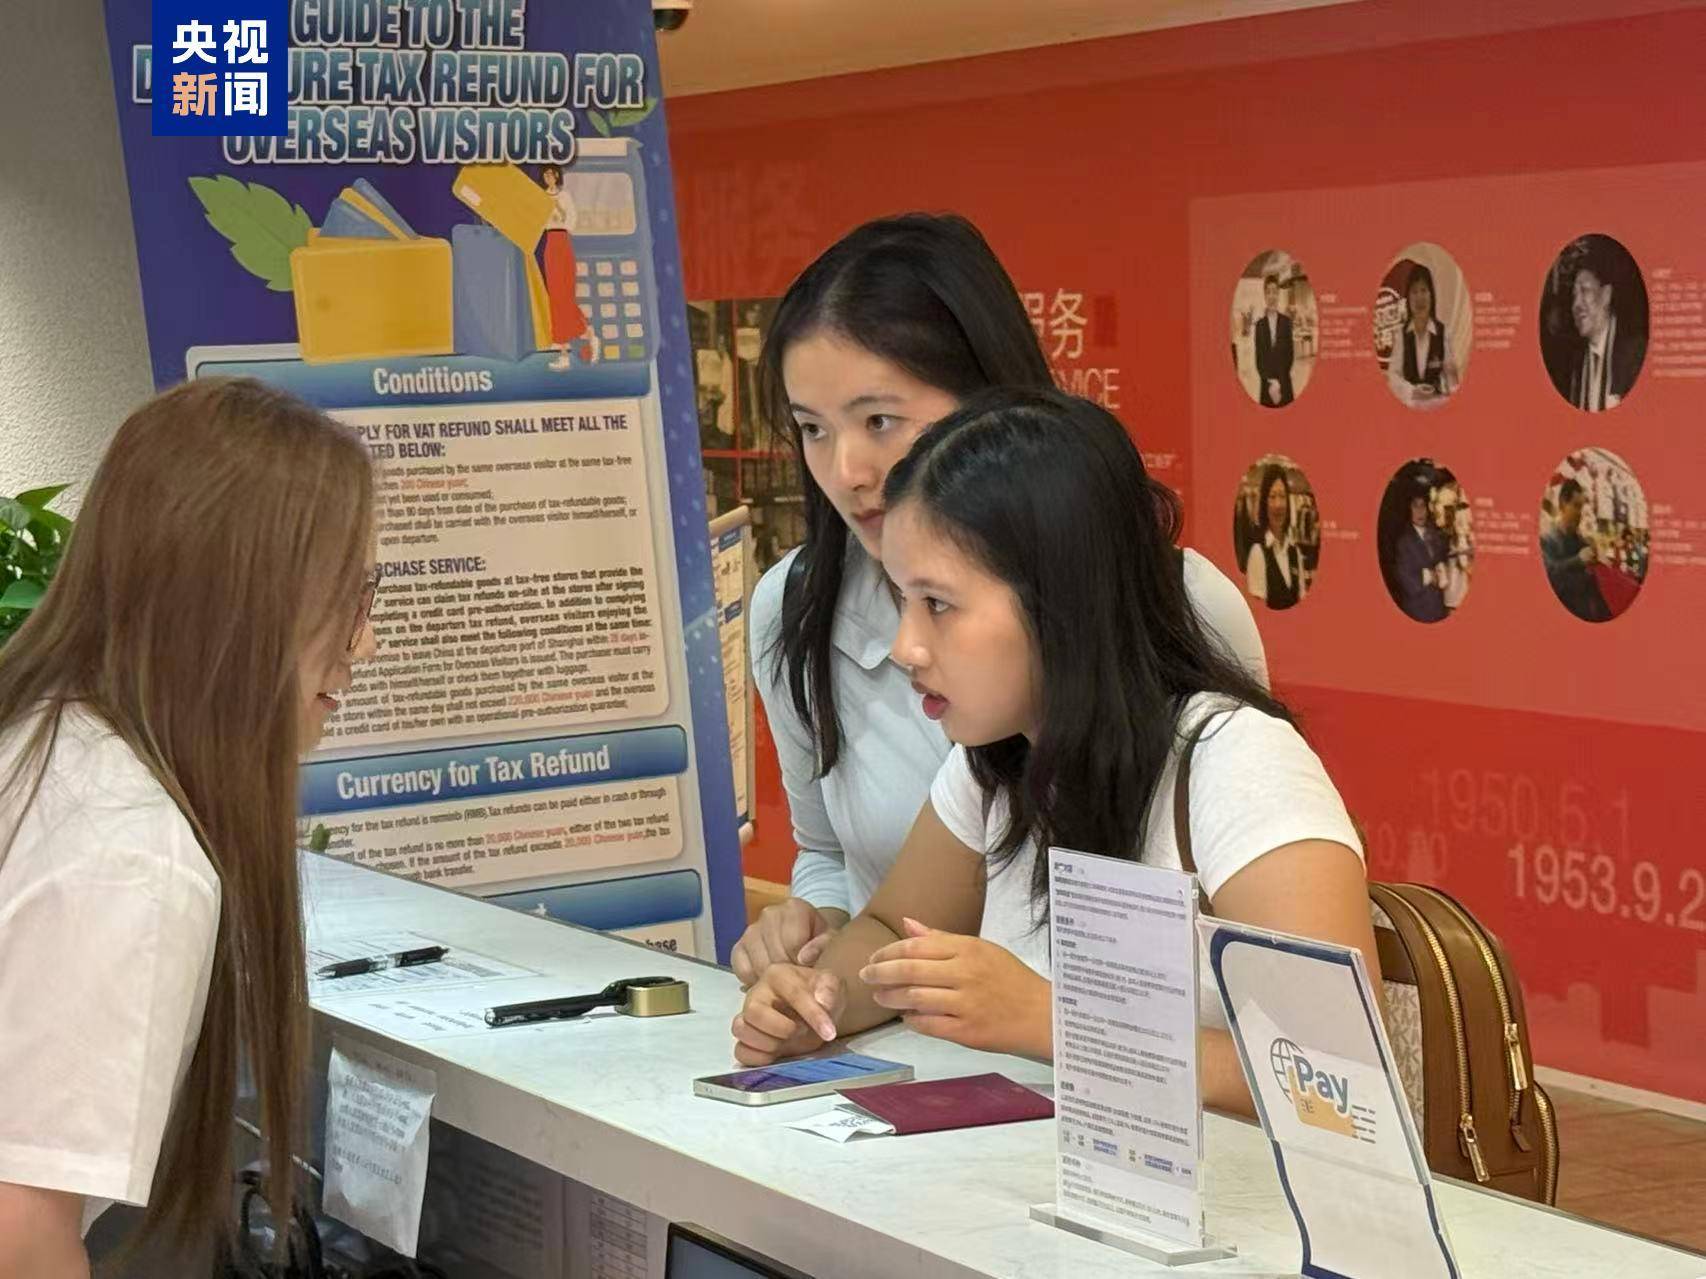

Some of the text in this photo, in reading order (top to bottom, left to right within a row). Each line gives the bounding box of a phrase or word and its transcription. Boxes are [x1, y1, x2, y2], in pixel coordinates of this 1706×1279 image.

[291, 0, 525, 51] GUIDE TO THE
[358, 49, 425, 105] TAX
[427, 51, 569, 108] REFUND
[574, 53, 645, 109] FOR
[419, 107, 576, 165] VISITORS
[373, 366, 493, 396] Conditions
[385, 423, 412, 440] FOR
[412, 422, 436, 438] VAT
[440, 420, 491, 438] REFUND
[495, 418, 539, 436] SHALL
[541, 416, 574, 432] MEET
[578, 416, 602, 431] ALL
[602, 414, 628, 430] THE
[398, 441, 446, 458] BELOW:
[428, 556, 486, 576] SERVICE:
[414, 578, 473, 591] tax-refundable
[516, 573, 550, 584] tax-free
[580, 569, 596, 580] that
[599, 567, 628, 581] provide
[384, 595, 414, 606] service
[420, 606, 443, 618] credit
[336, 744, 610, 801] Currency for Tax Refund
[533, 802, 548, 811] can
[560, 796, 578, 810] paid
[646, 810, 670, 823] refund
[1293, 1054, 1348, 1114] Pay
